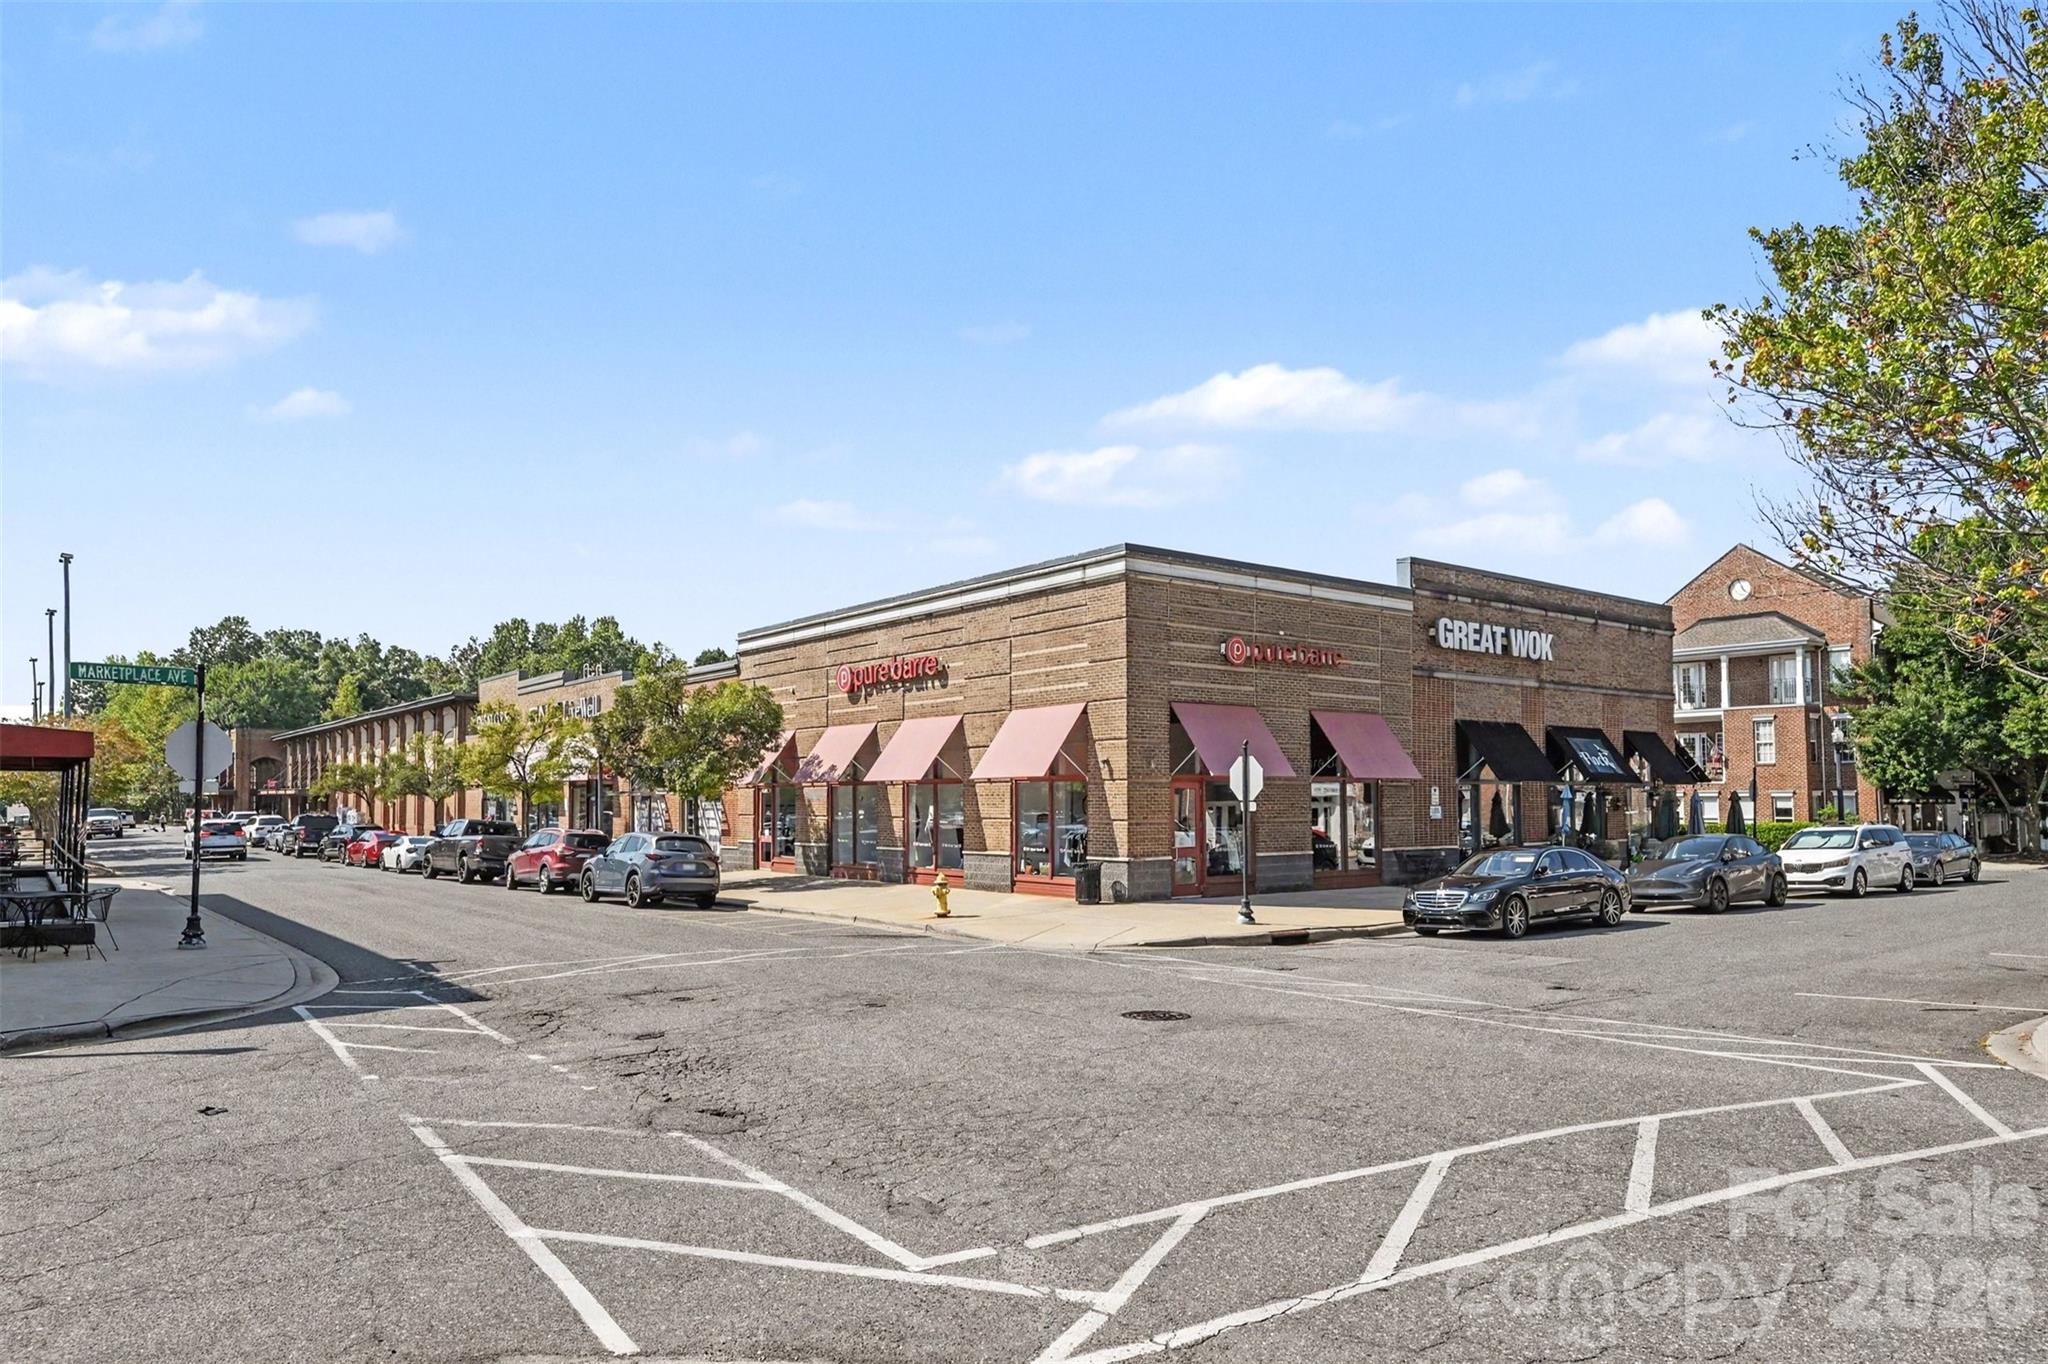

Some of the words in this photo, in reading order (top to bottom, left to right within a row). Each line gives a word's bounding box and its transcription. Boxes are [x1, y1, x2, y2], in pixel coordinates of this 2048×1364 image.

[1438, 617, 1505, 655] GREAT
[1509, 628, 1553, 661] WOK
[78, 664, 161, 682] MARKETPLACE
[165, 670, 188, 684] AVE
